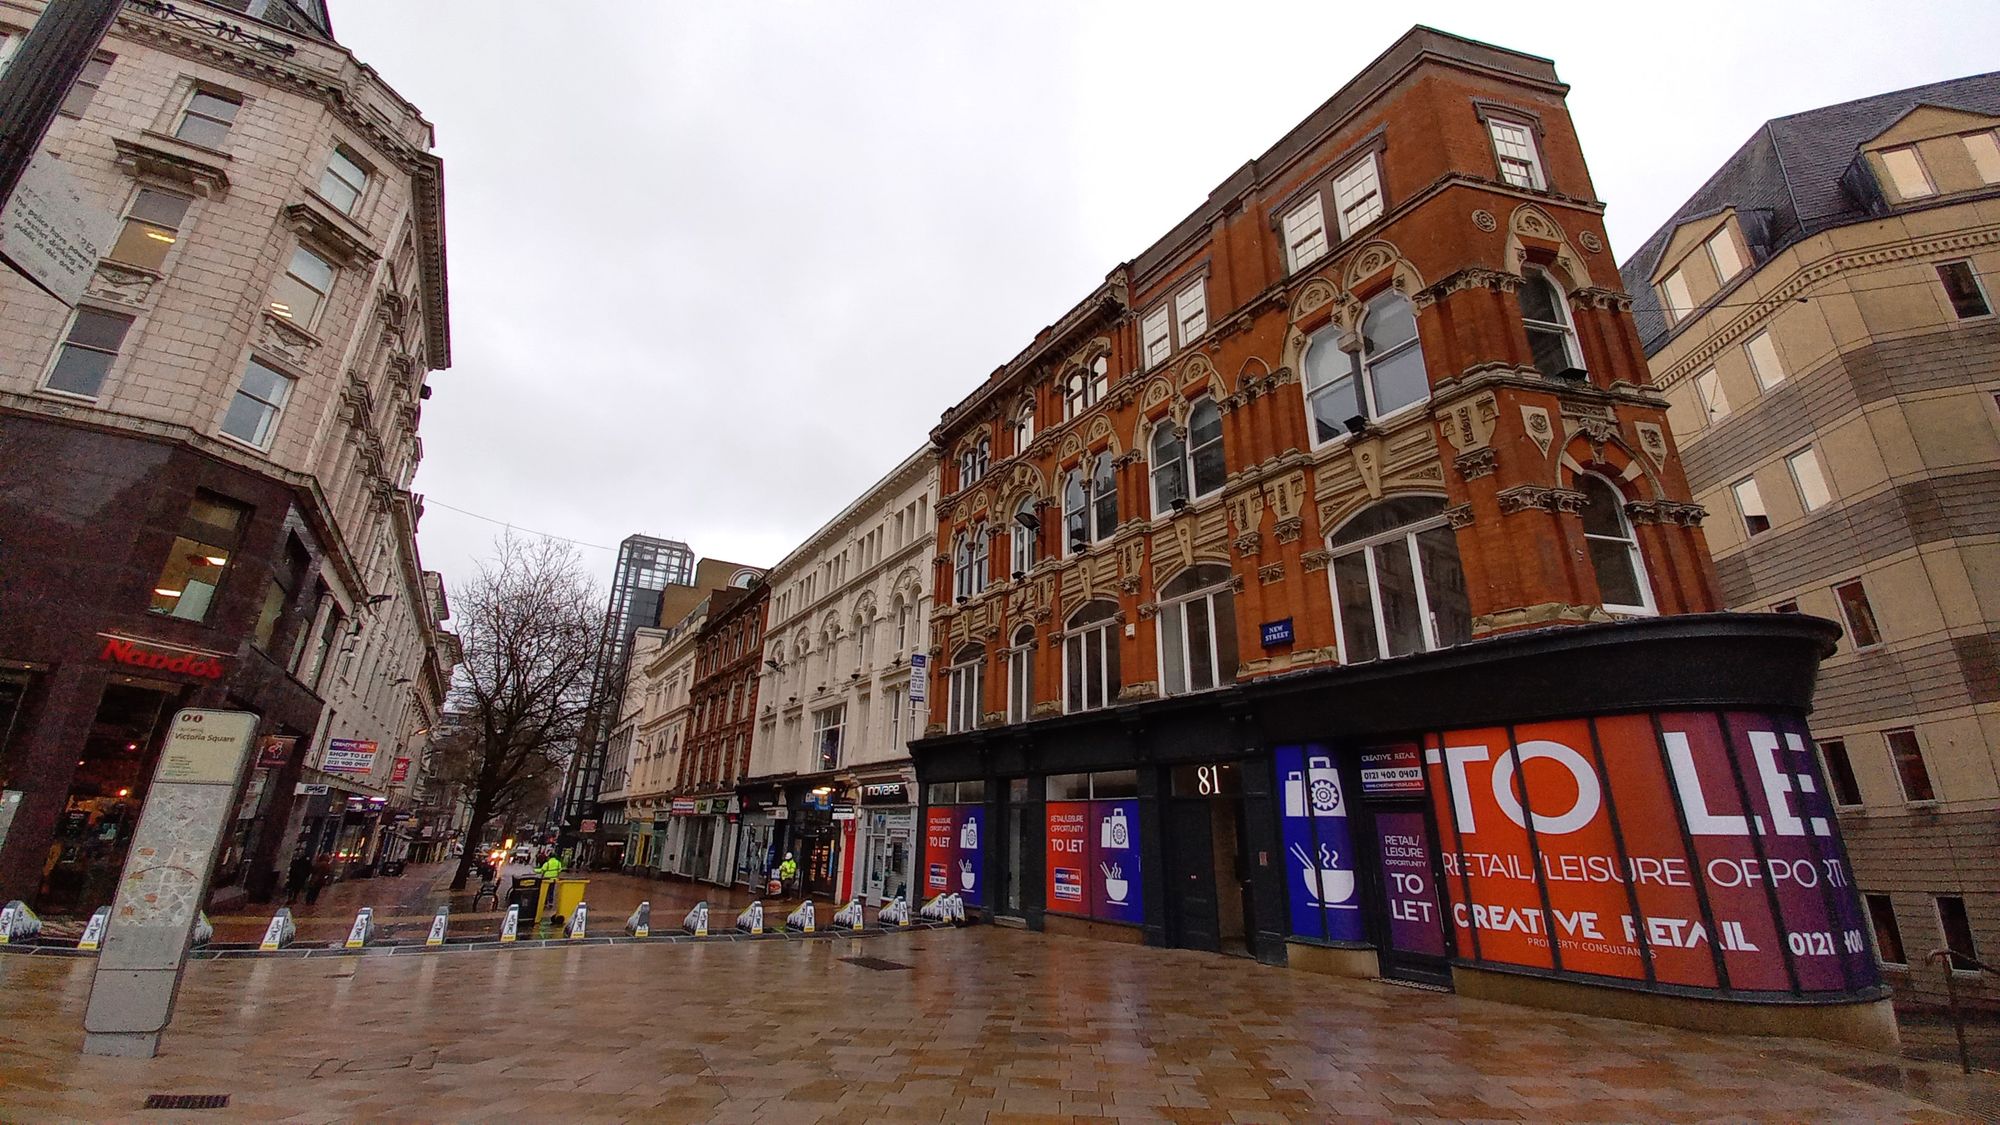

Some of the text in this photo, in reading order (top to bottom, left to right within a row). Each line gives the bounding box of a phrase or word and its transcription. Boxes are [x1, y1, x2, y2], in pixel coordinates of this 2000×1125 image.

[14, 208, 22, 218] to
[23, 217, 48, 240] restrict
[48, 239, 77, 265] drinking
[15, 194, 27, 209] The
[27, 209, 49, 229] police
[49, 226, 67, 245] have
[68, 245, 93, 267] powers
[14, 222, 36, 242] public
[45, 247, 58, 261] this
[58, 260, 75, 276] area
[1264, 630, 1289, 642] STREET
[1268, 624, 1284, 634] NEW
[99, 638, 224, 679] Nando's
[174, 732, 236, 743] Victoria Square
[1361, 751, 1416, 762] CREATIVE RETAIL
[1197, 764, 1222, 796] 81
[1363, 769, 1419, 780] 0121 400 0407
[1424, 740, 1601, 835] TO
[929, 836, 951, 848] TO LET
[1050, 838, 1084, 853] TO LET
[1384, 834, 1420, 847] RETAIL/
[1384, 846, 1424, 858] LEISURE
[1384, 858, 1427, 868] OPPORTUNITY
[1390, 872, 1425, 895] TO
[1391, 898, 1433, 923] LET
[1620, 914, 1761, 952] RETAIL
[1787, 931, 1836, 956] 0121
[1527, 937, 1657, 960] PROERTY CONSULTANS
